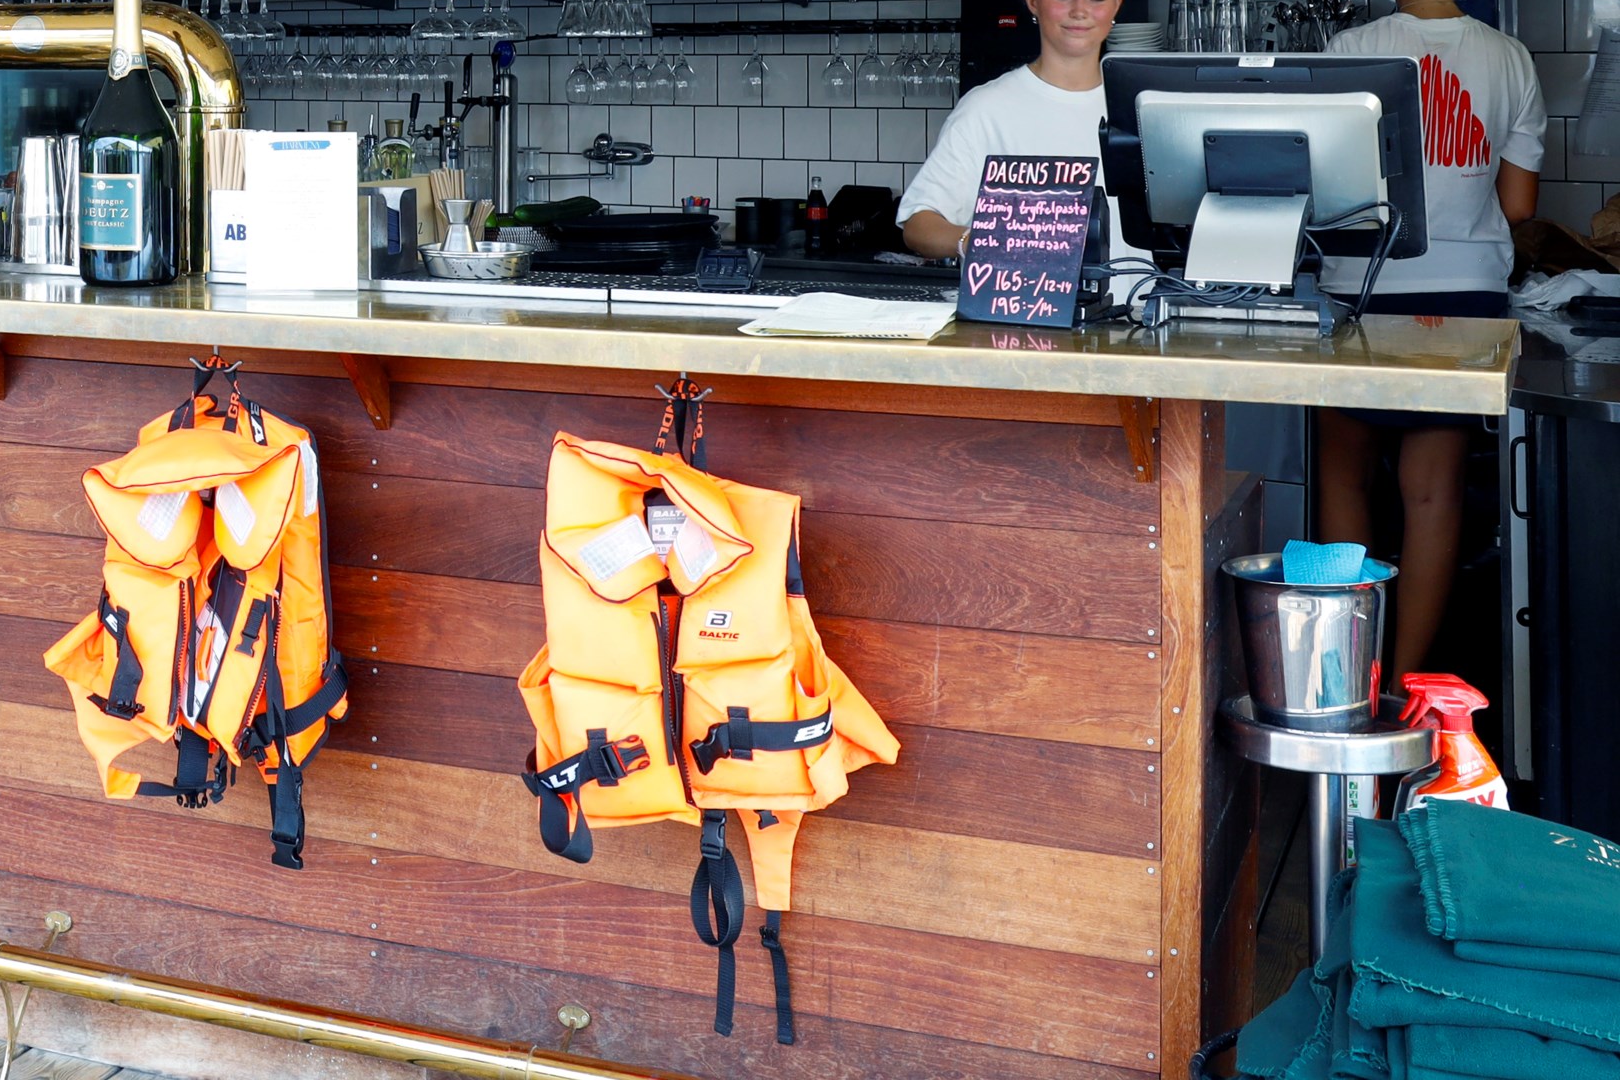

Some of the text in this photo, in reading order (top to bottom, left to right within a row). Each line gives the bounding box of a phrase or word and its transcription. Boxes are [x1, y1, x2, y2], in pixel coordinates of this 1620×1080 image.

[986, 160, 1092, 185] DAGENS TIPS
[1019, 198, 1088, 223] tryffelpasta
[972, 217, 996, 231] med
[974, 235, 1070, 252] och parmesan
[699, 631, 739, 639] BALTIC
